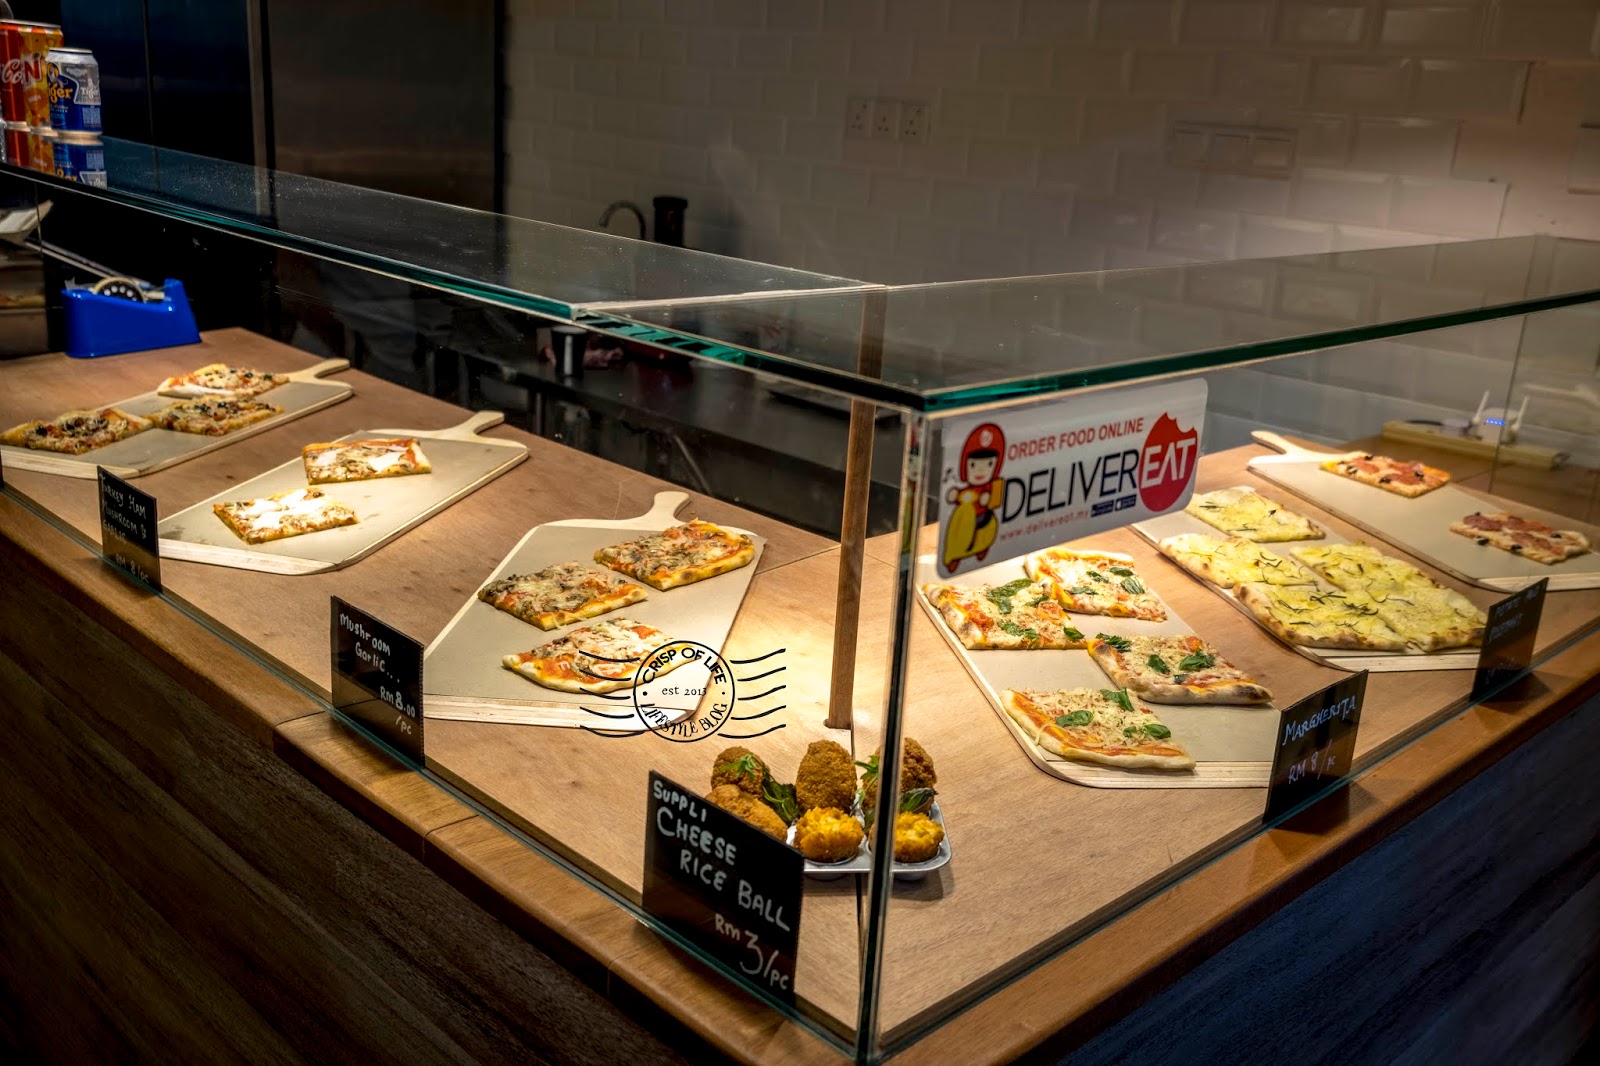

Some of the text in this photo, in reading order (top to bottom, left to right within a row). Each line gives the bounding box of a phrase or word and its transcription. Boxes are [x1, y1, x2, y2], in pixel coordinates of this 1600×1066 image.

[1007, 417, 1145, 462] ORDER FOOD ONLINE
[653, 779, 707, 822] SUPPLI
[656, 806, 737, 866] CHEESE
[680, 849, 791, 932] RICE BALL
